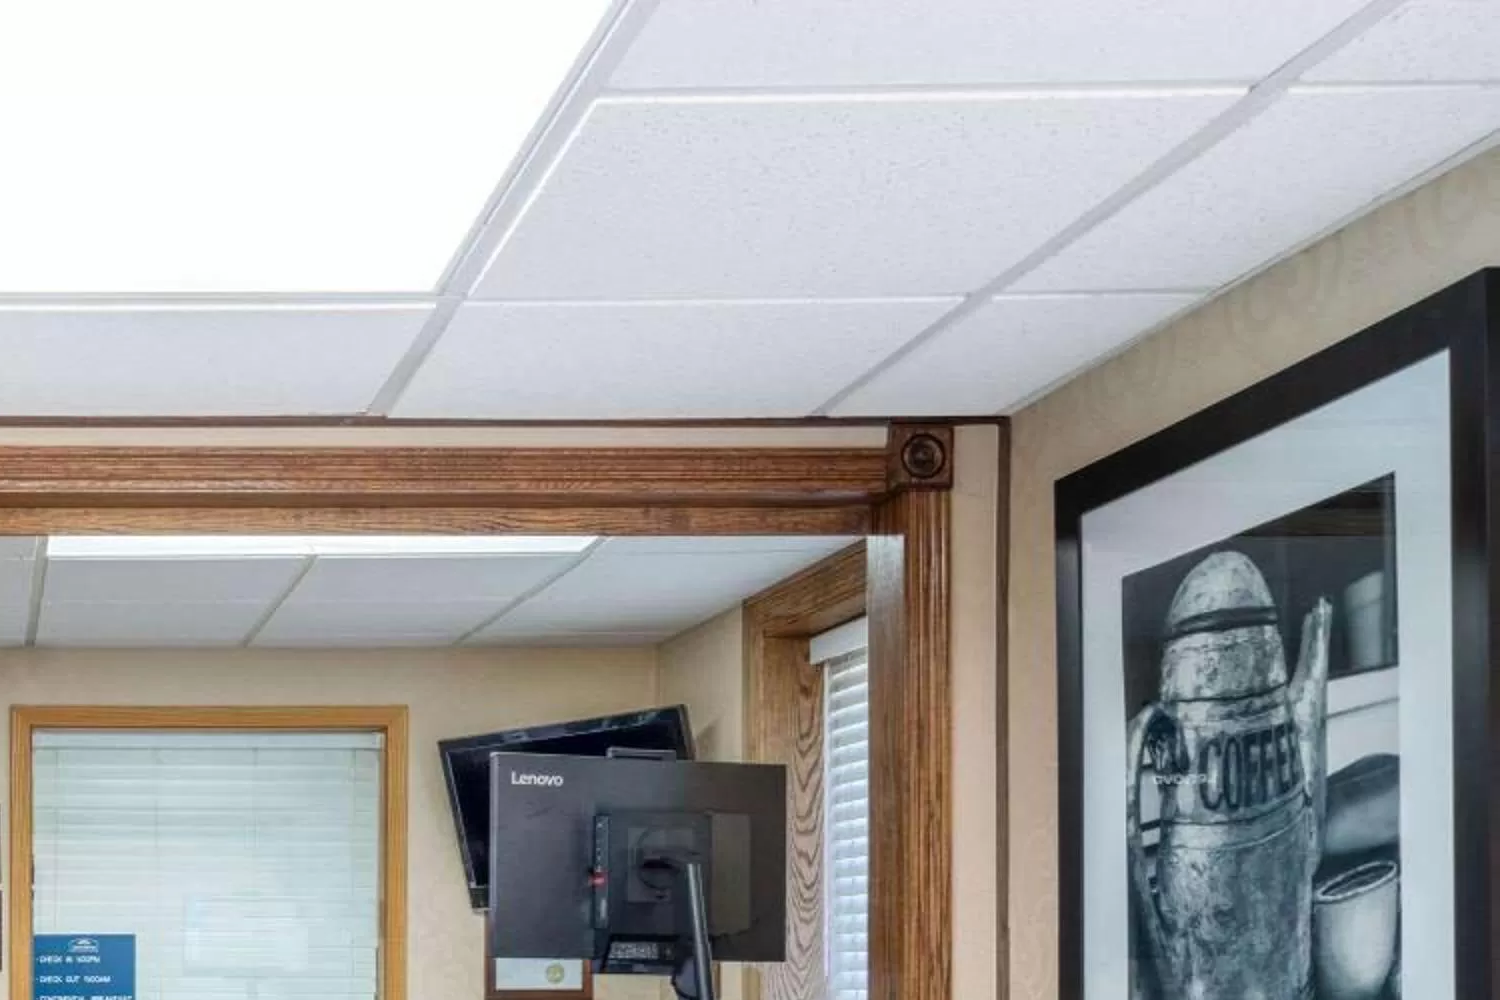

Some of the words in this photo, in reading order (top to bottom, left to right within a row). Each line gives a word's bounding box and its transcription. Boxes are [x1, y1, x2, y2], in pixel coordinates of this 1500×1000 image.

[511, 770, 565, 787] Lenovo
[39, 955, 63, 964] CHECK
[39, 975, 63, 983] CHECK
[65, 975, 81, 983] OUT
